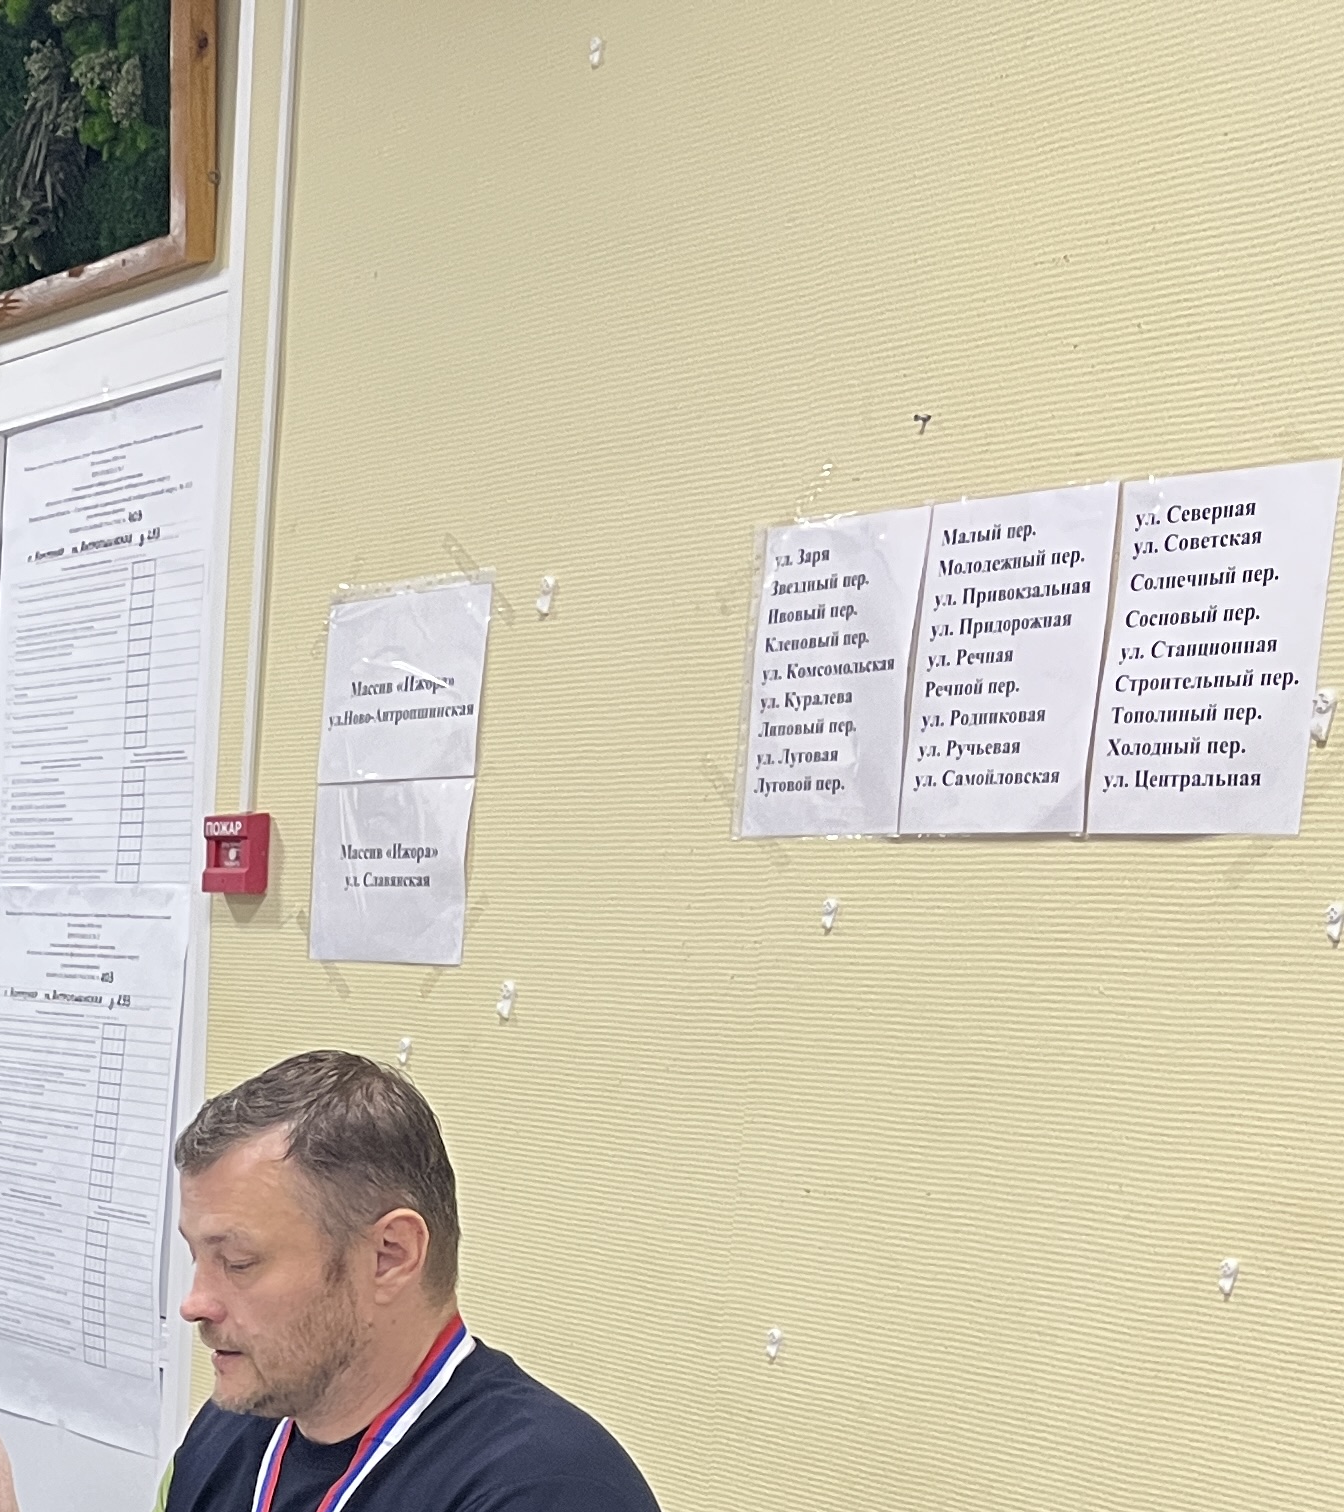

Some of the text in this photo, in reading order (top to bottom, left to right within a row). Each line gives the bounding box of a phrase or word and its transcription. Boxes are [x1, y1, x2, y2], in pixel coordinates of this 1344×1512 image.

[1135, 502, 1256, 531] ул. Северная
[942, 524, 1036, 546] Малый пер.
[1133, 531, 1262, 560] ул. Советская
[775, 549, 830, 571] ул. Заря
[938, 549, 1085, 577] Молодежный пер.
[771, 573, 869, 596] Звездный пер.
[1131, 566, 1279, 592] Солнечный пер.
[933, 580, 1091, 611] ул. Привокзальная
[768, 604, 857, 624] Ивовый пер.
[1125, 605, 1260, 628] Сосновый пер.
[930, 613, 1072, 642] ул. Придорожная
[765, 631, 869, 652] Кленовый пер.
[1119, 639, 1277, 665] ул. Станционная
[762, 658, 894, 685] ул. Комсомольская
[927, 649, 1013, 672] ул. Речная
[351, 681, 393, 698] Массив
[925, 678, 1019, 697] Речной пер.
[1115, 669, 1299, 696] Строительный пер.
[760, 691, 852, 713] ул. Куралева
[921, 709, 1046, 732] ул. Родниковая
[1111, 704, 1262, 725] Тополиный пер.
[758, 718, 856, 738] Липовый пер.
[756, 748, 838, 769] ул. Луговая
[918, 739, 1020, 762] ул. Ручьевая
[1107, 737, 1246, 759] Холодный пер.
[754, 776, 844, 797] Луговой пер.
[913, 769, 1060, 791] ул. Самойловская
[1103, 770, 1261, 792] ул. Центральная
[206, 821, 242, 836] ПОЖАР
[340, 844, 382, 860] Массив
[363, 872, 430, 887] Славянская
